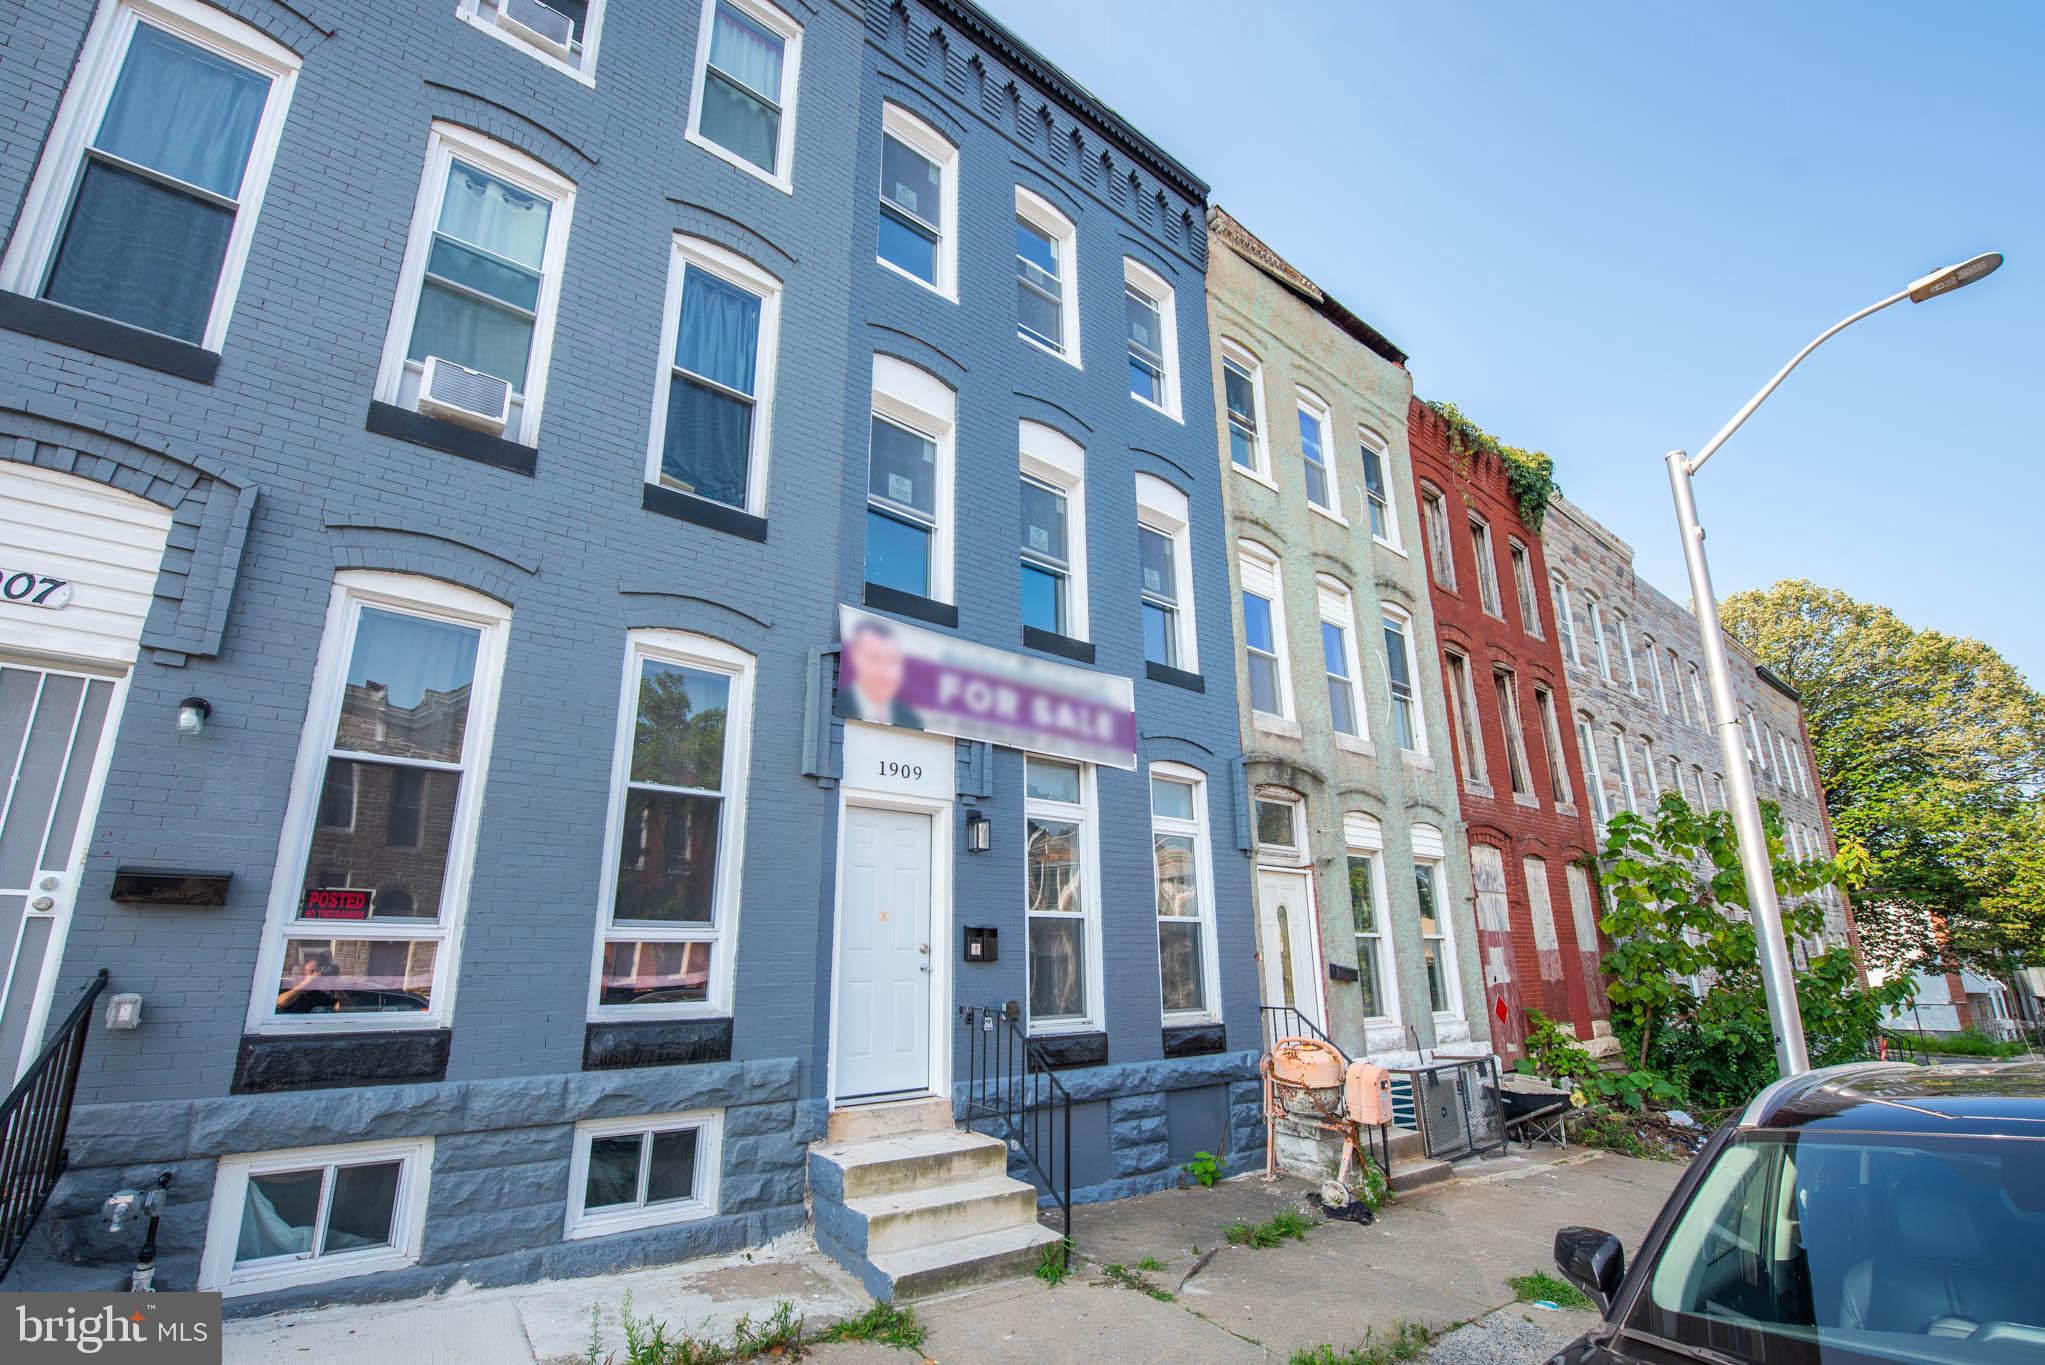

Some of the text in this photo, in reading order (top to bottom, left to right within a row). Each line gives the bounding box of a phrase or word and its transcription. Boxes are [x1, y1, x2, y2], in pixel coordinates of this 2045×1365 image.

[0, 570, 67, 604] 07
[937, 671, 1018, 718] FOR
[1031, 696, 1114, 741] SALE
[879, 761, 922, 780] 1909
[309, 890, 366, 909] POSTED
